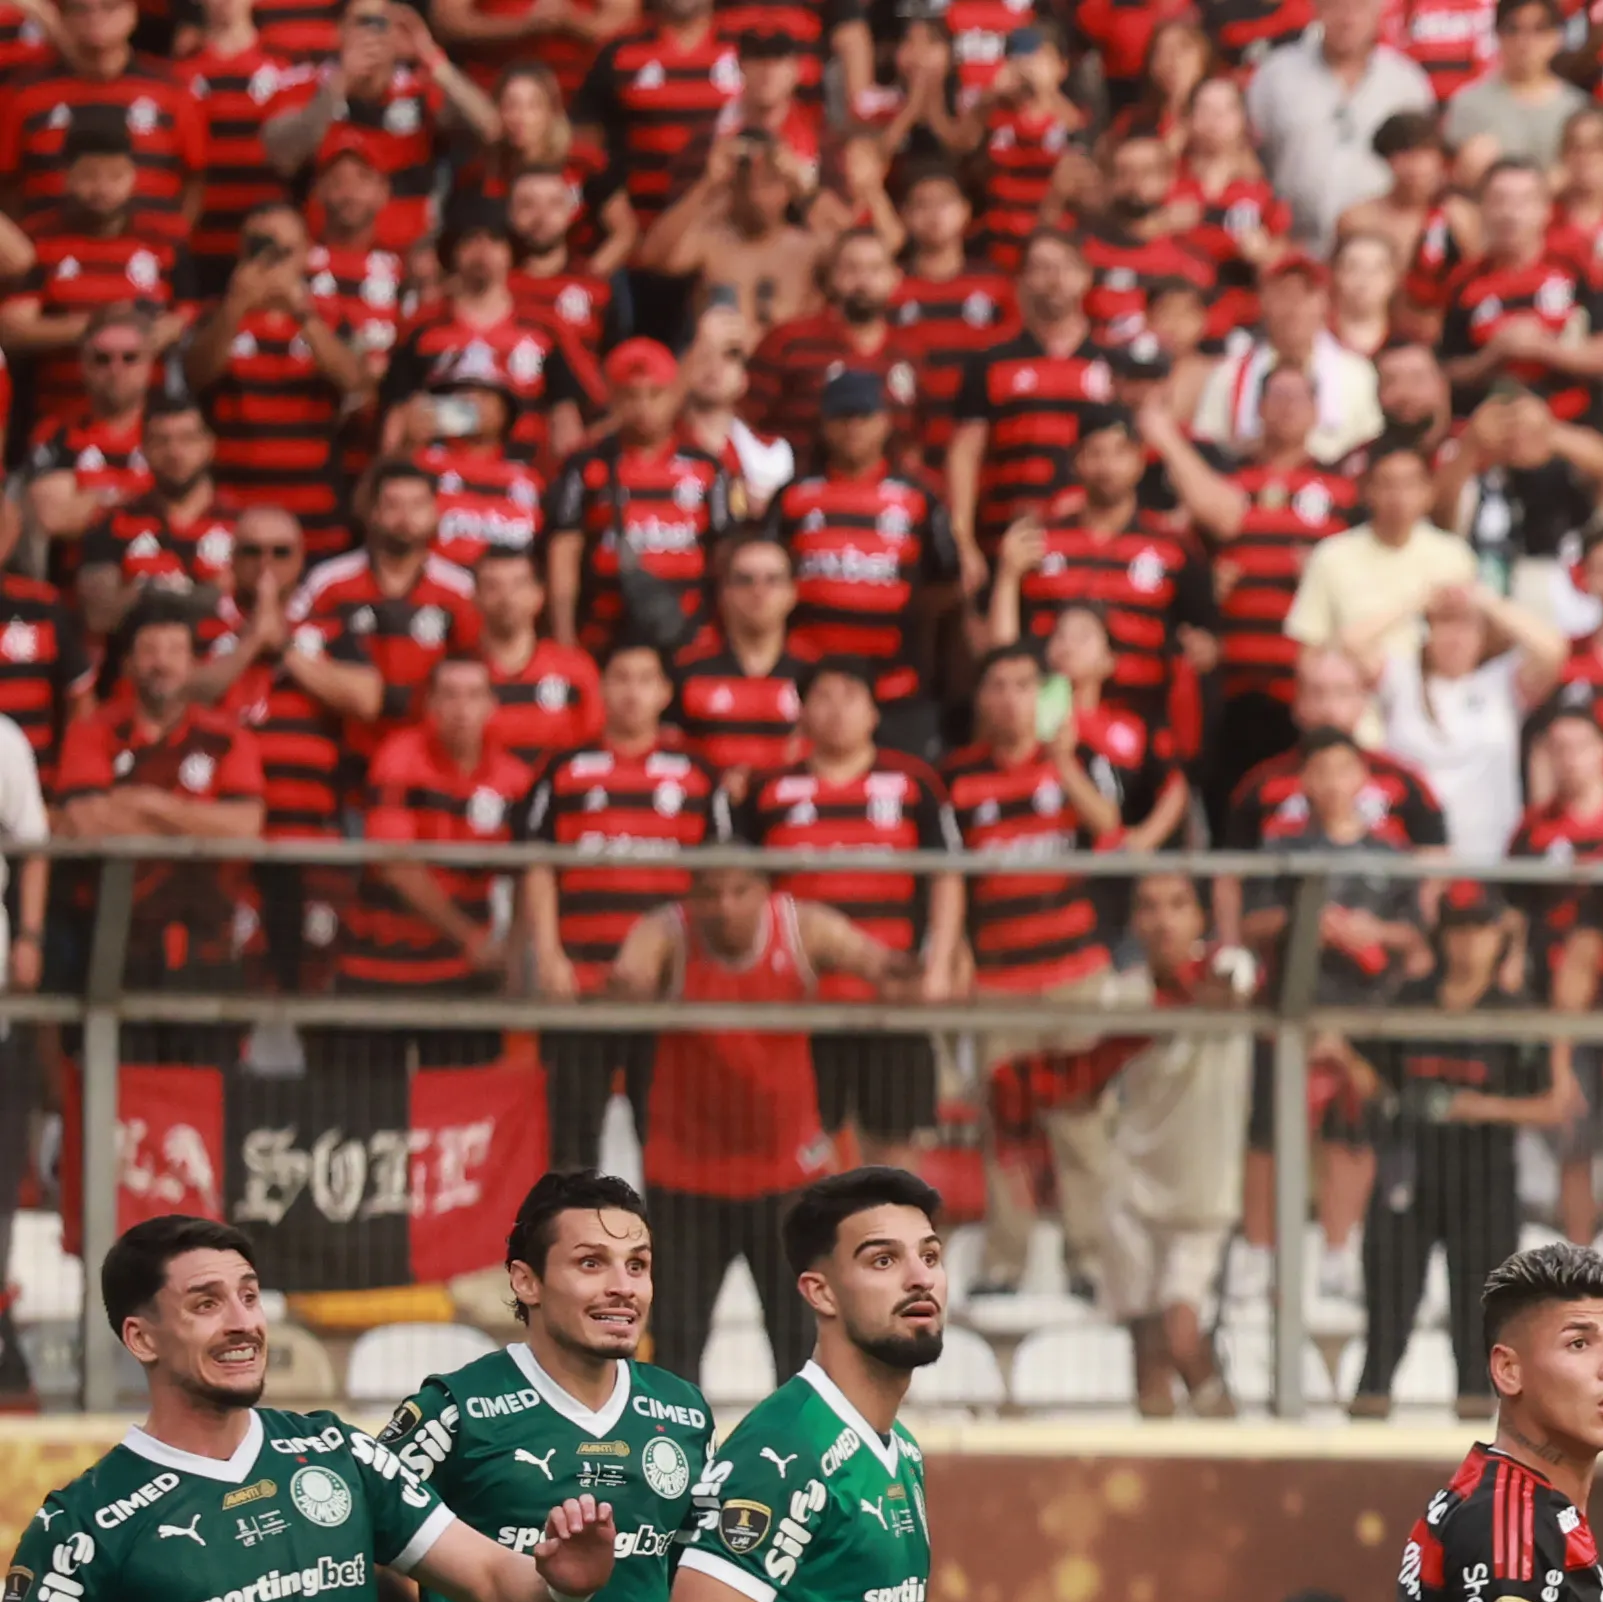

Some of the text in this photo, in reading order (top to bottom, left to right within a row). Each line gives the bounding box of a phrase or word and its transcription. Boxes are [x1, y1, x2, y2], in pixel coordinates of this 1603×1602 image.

[466, 1389, 541, 1420] CIMED
[632, 1395, 706, 1429] CIMED
[270, 1426, 345, 1454] CIMED
[821, 1427, 861, 1477] CIMED
[95, 1472, 180, 1529] CIMED
